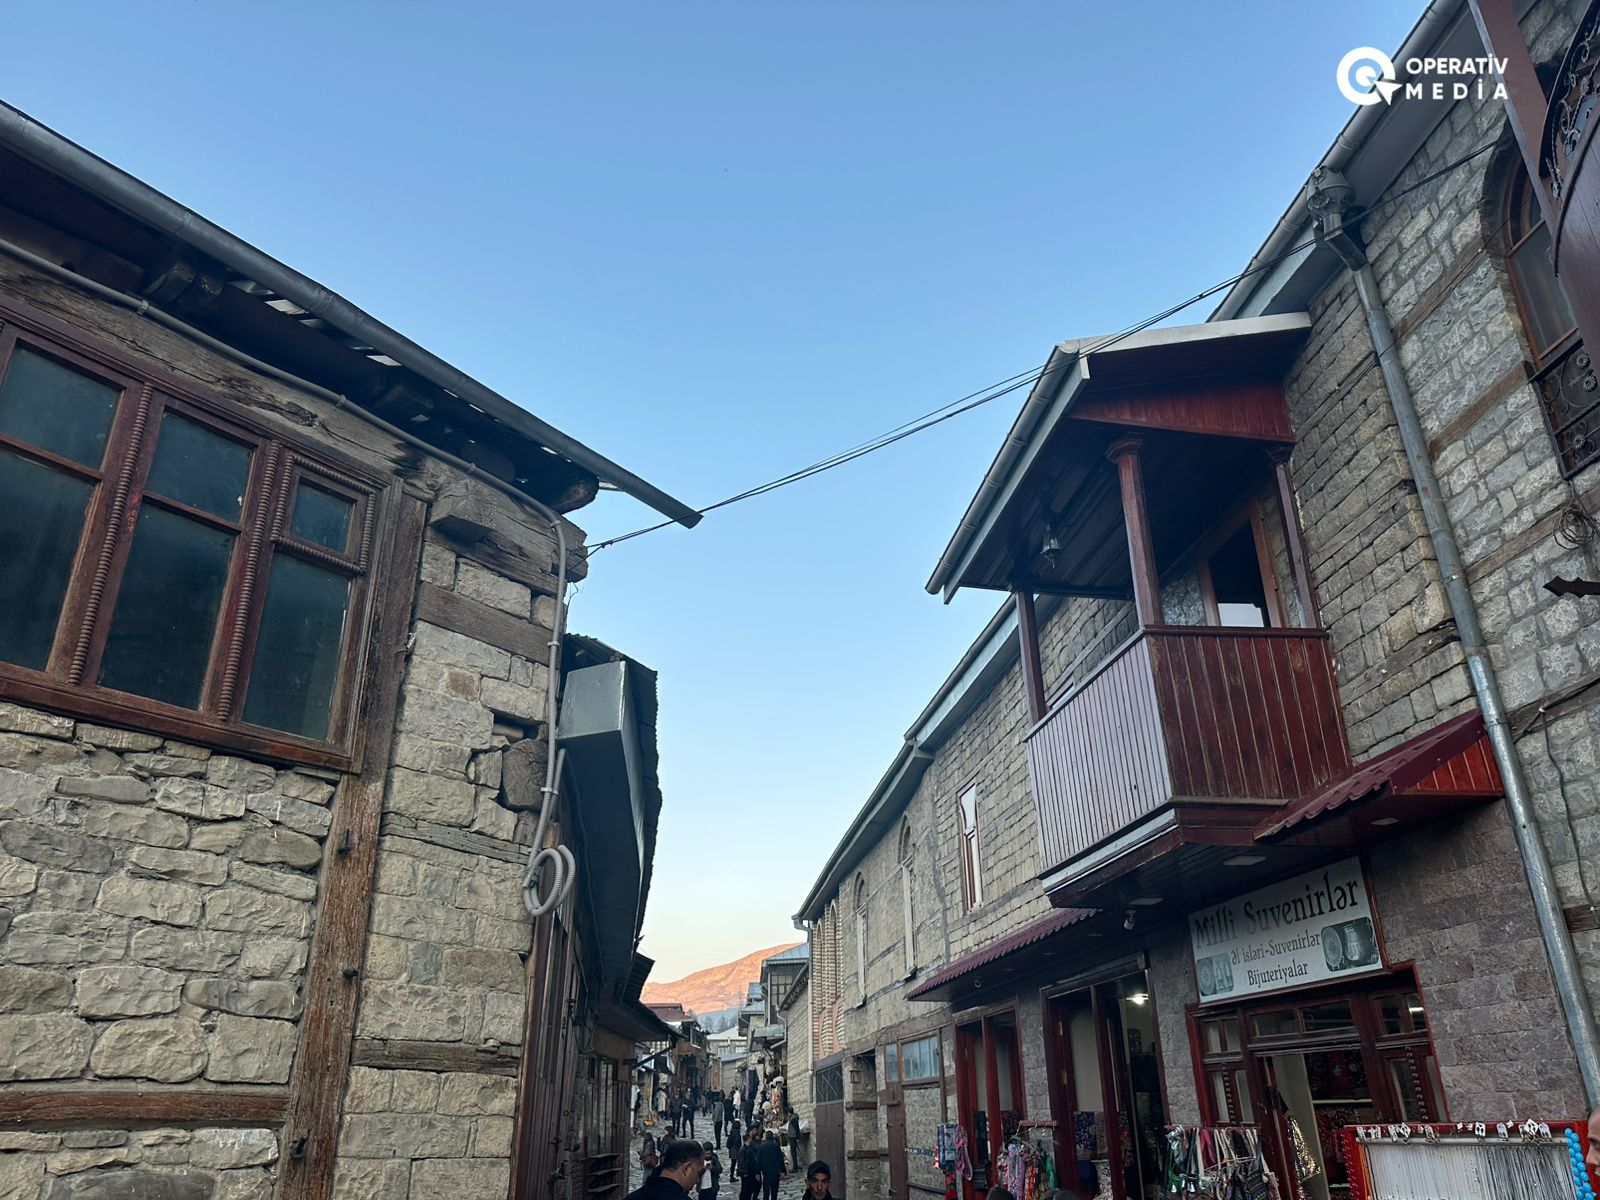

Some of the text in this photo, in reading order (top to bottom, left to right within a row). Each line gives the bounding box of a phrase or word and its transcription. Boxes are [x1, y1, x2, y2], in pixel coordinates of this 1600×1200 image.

[1194, 871, 1359, 949] Milli Suvenirlər
[1247, 958, 1308, 988] Bijuteriyalar
